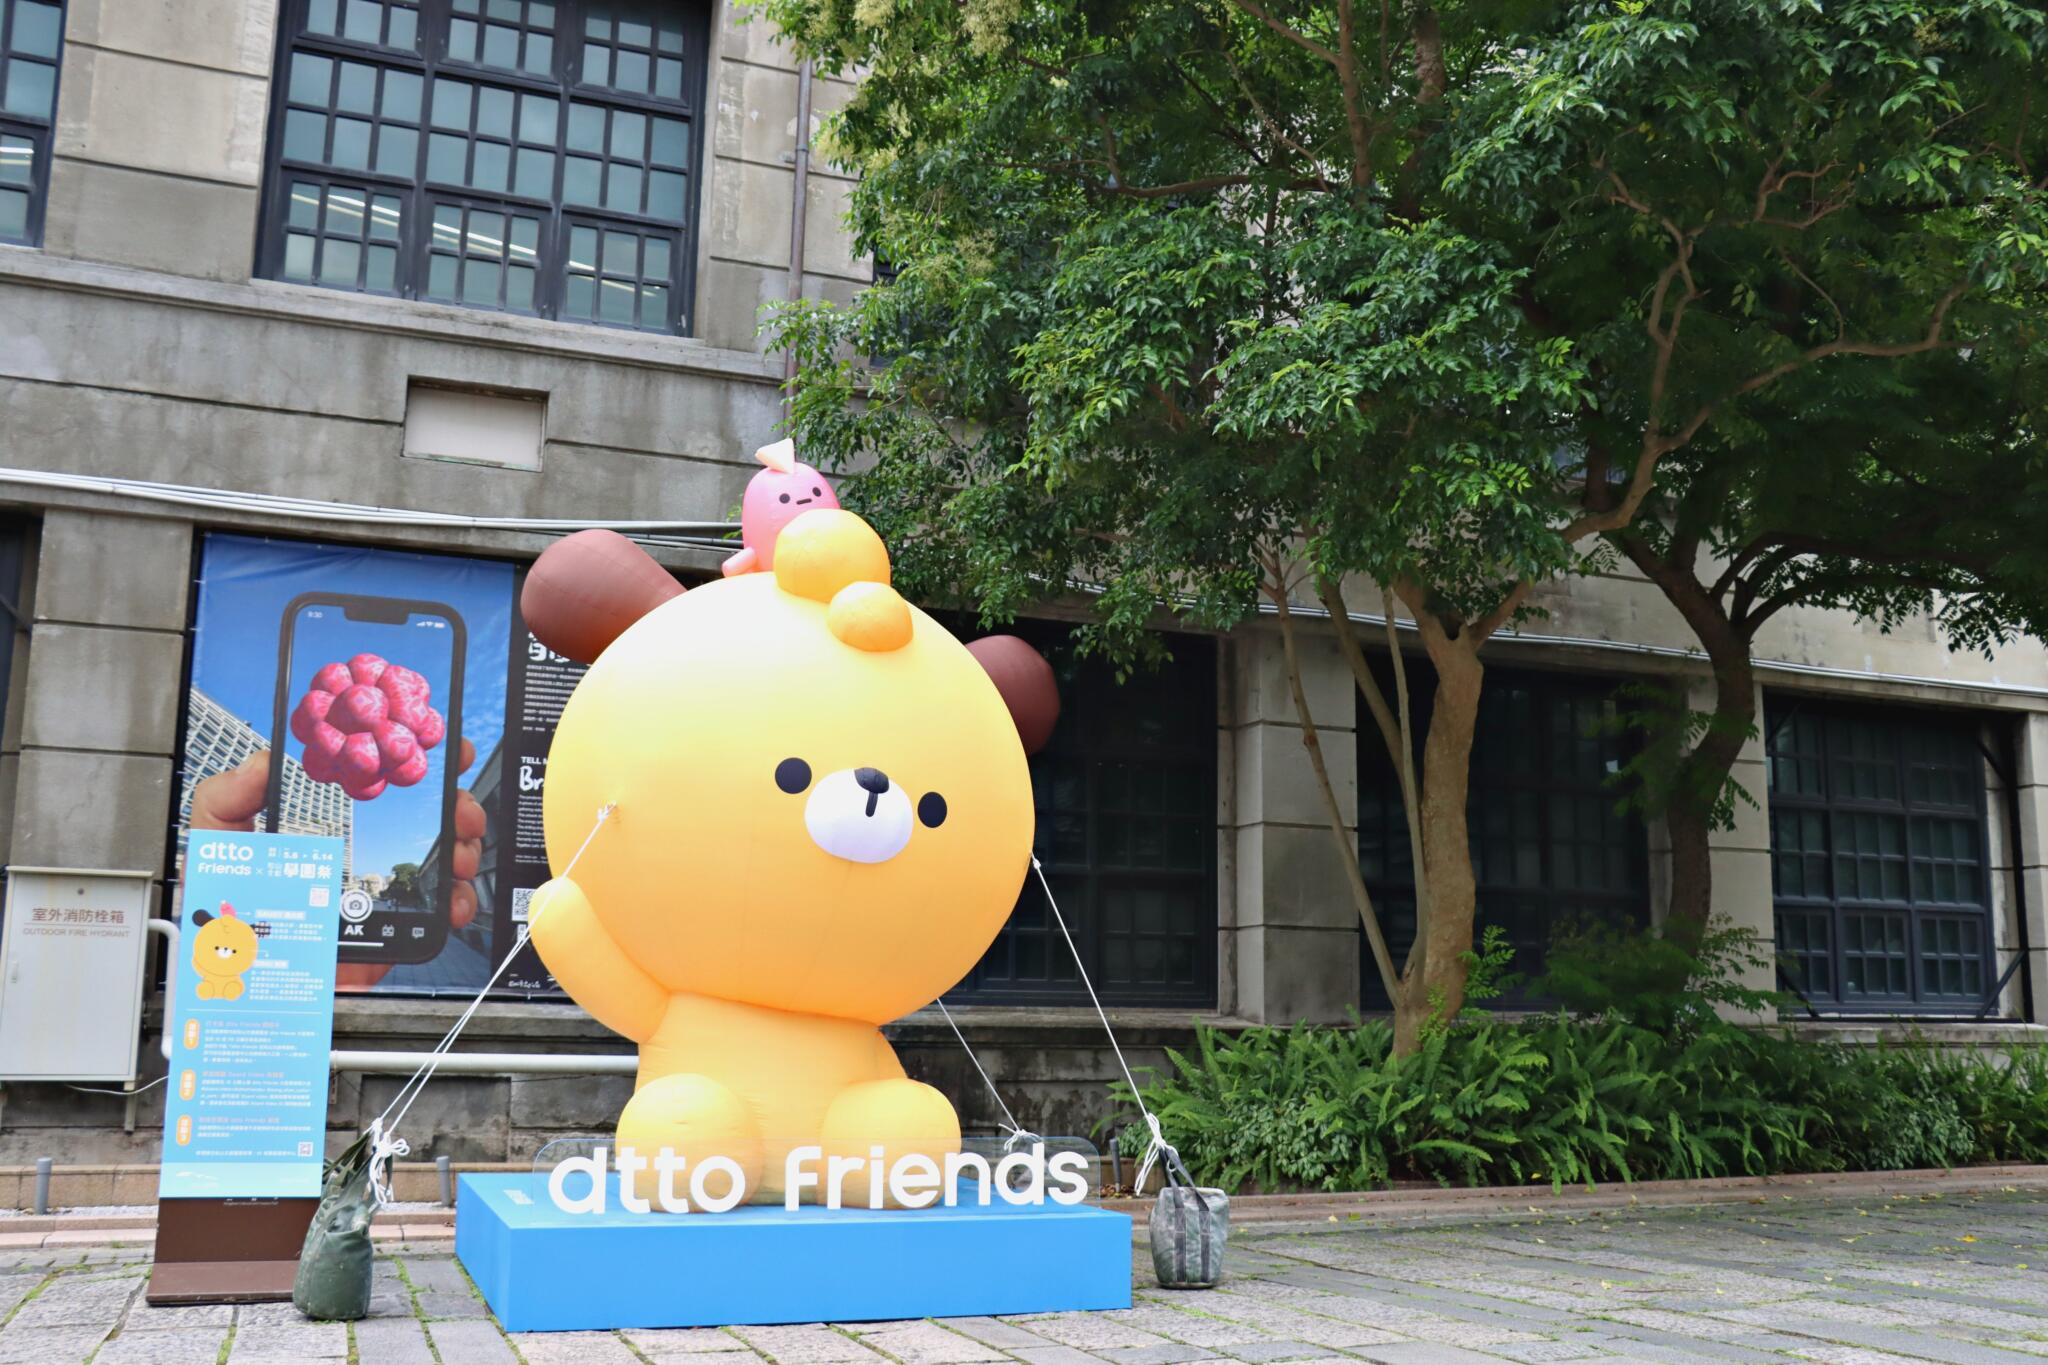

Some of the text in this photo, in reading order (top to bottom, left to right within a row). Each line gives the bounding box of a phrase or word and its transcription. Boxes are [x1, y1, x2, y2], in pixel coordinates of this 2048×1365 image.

[520, 756, 541, 765] TELL
[199, 841, 254, 861] dtto
[32, 907, 125, 925] 室外消防栓箱
[22, 927, 67, 936] OUTDOOR
[89, 930, 130, 938] HYDRANT
[548, 1146, 746, 1214] dtto
